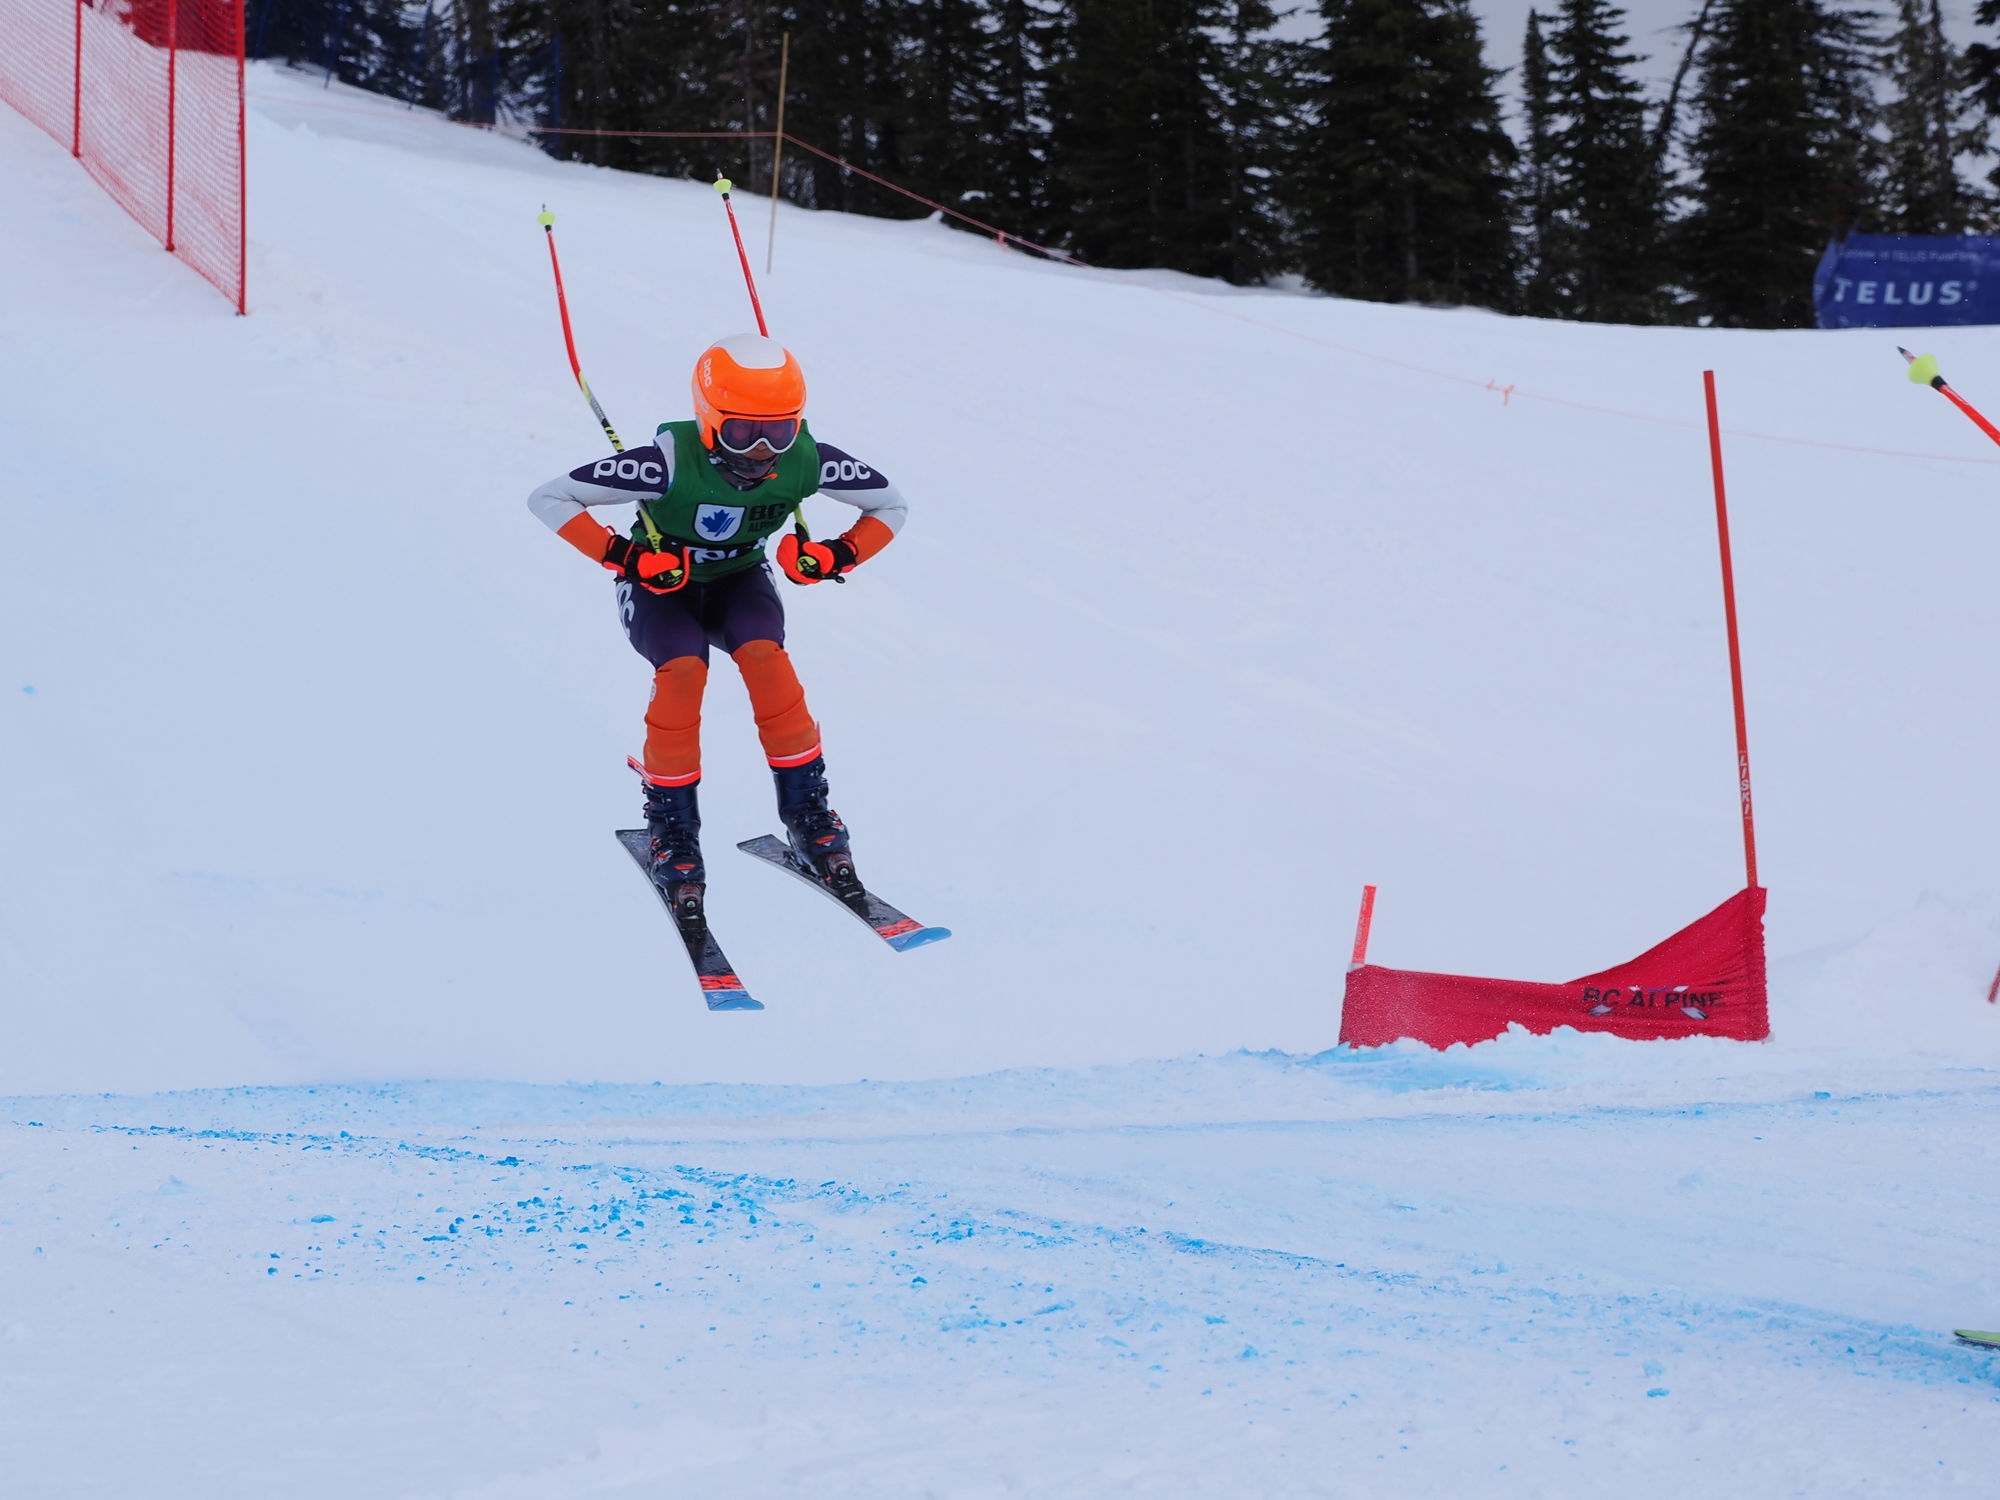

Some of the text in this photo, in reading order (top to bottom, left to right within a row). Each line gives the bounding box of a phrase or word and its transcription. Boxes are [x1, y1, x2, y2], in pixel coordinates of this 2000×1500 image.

[1834, 278, 1962, 305] TELUS
[593, 459, 663, 484] POC
[818, 460, 871, 485] POC
